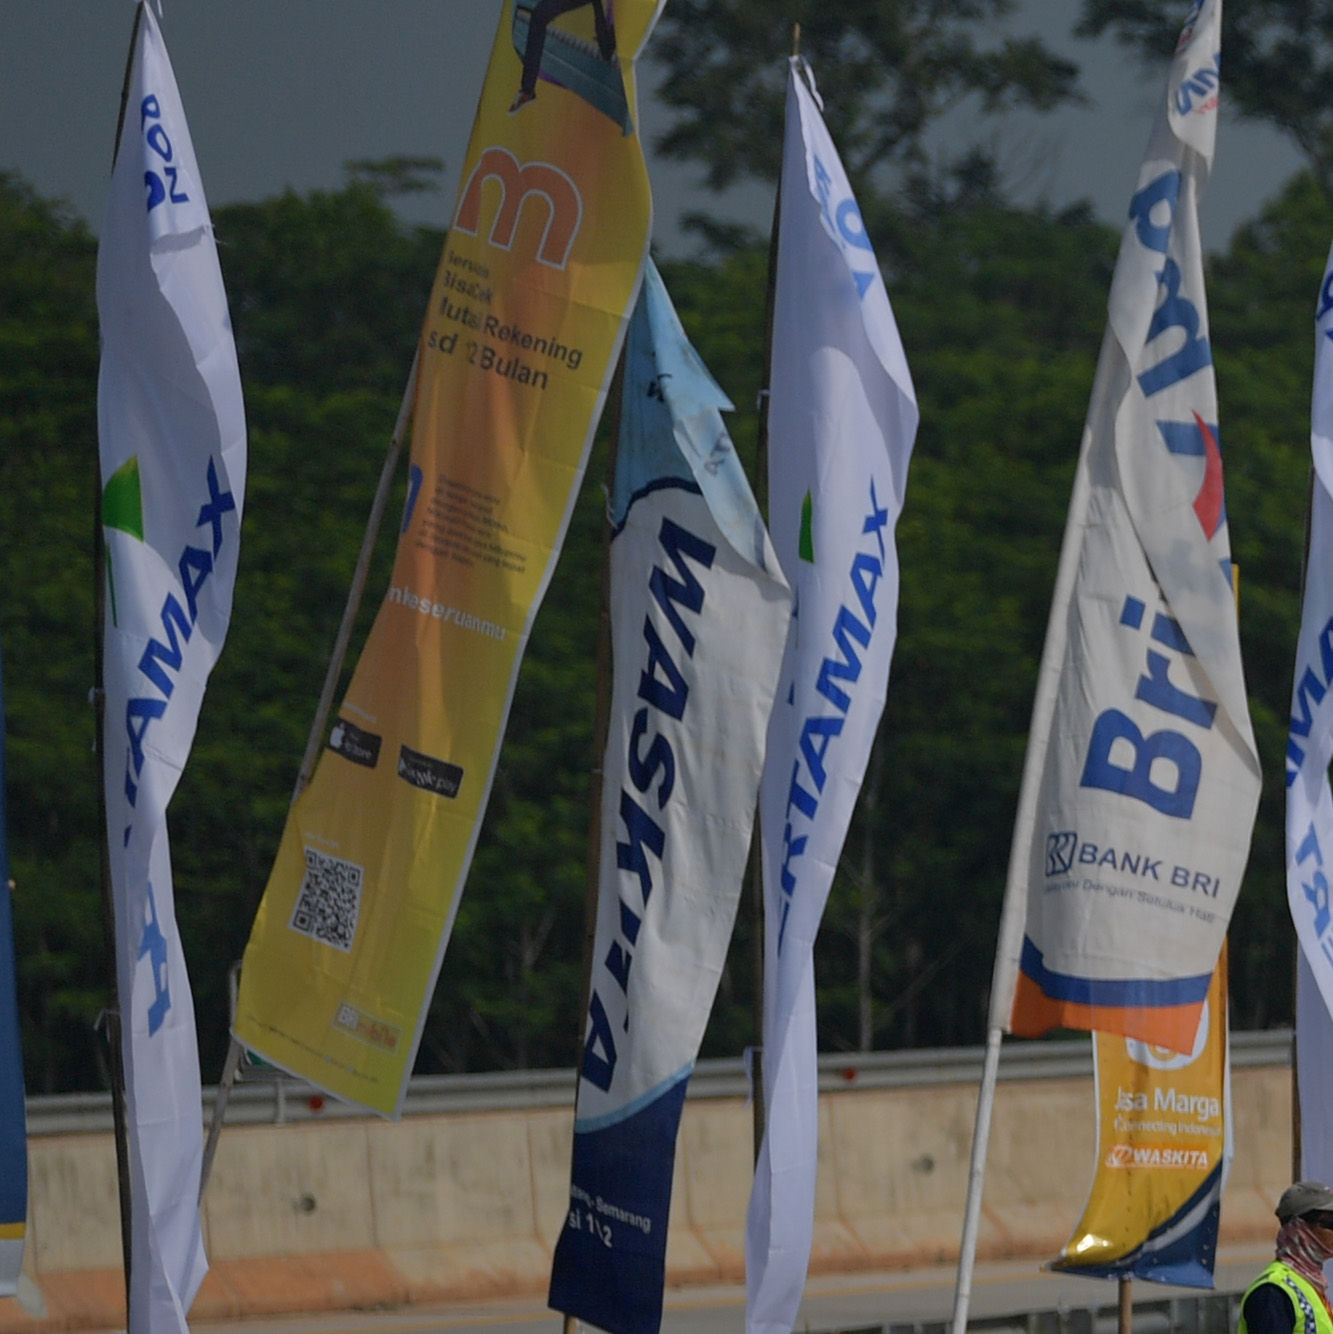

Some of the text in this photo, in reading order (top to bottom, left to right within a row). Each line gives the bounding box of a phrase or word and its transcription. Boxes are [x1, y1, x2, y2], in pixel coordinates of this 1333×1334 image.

[484, 315, 582, 371] Rekening
[479, 345, 549, 391] Bulan
[1078, 842, 1221, 899] BANK BRI
[1153, 1086, 1219, 1123] Marga
[1132, 1147, 1210, 1171] WASKITA
